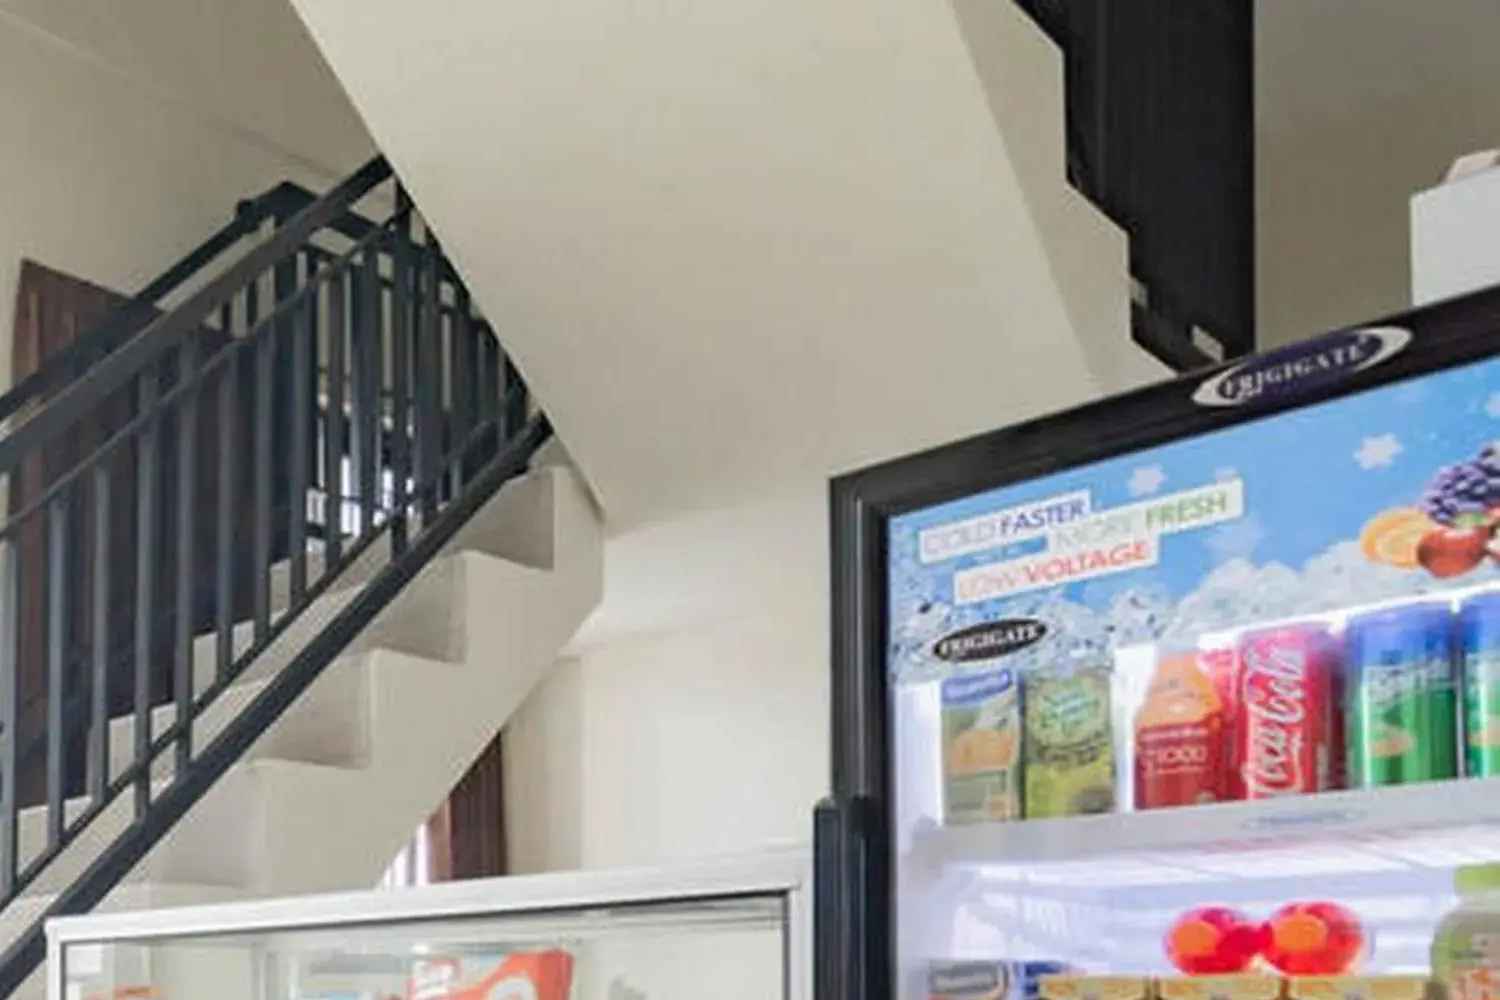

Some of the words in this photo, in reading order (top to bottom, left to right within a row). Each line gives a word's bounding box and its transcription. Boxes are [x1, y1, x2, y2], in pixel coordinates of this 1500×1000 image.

[1000, 499, 1088, 536] FASTER
[1146, 491, 1228, 529] FRESH
[1025, 540, 1149, 582] VOLTAGE
